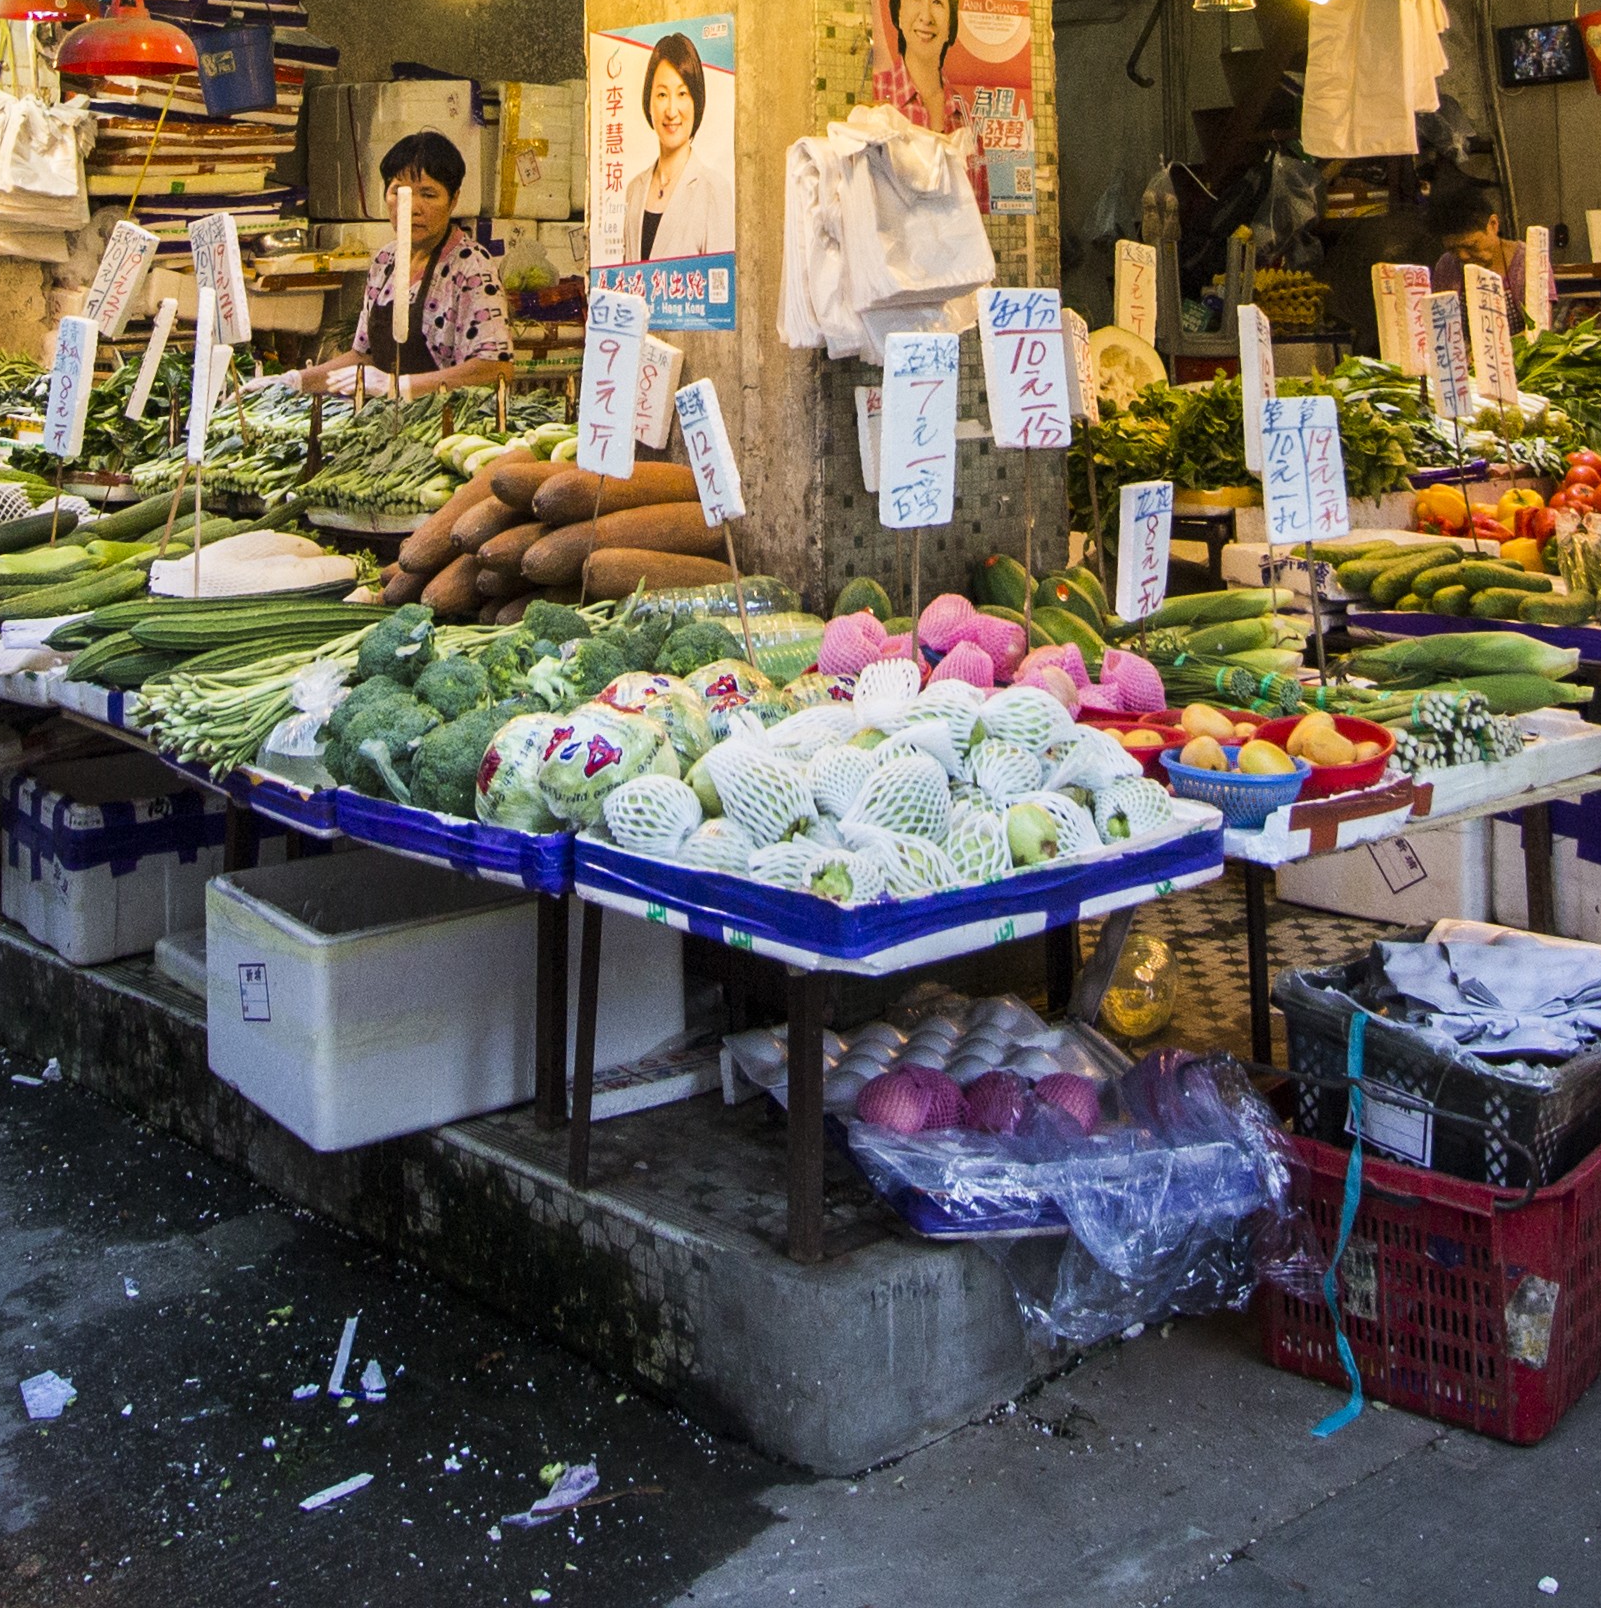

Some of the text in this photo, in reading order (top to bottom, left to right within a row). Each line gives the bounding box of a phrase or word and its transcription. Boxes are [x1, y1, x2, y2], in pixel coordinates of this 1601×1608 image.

[605, 86, 625, 191] 李慧琼
[603, 220, 618, 234] Lee
[662, 300, 706, 317] Hong Kong
